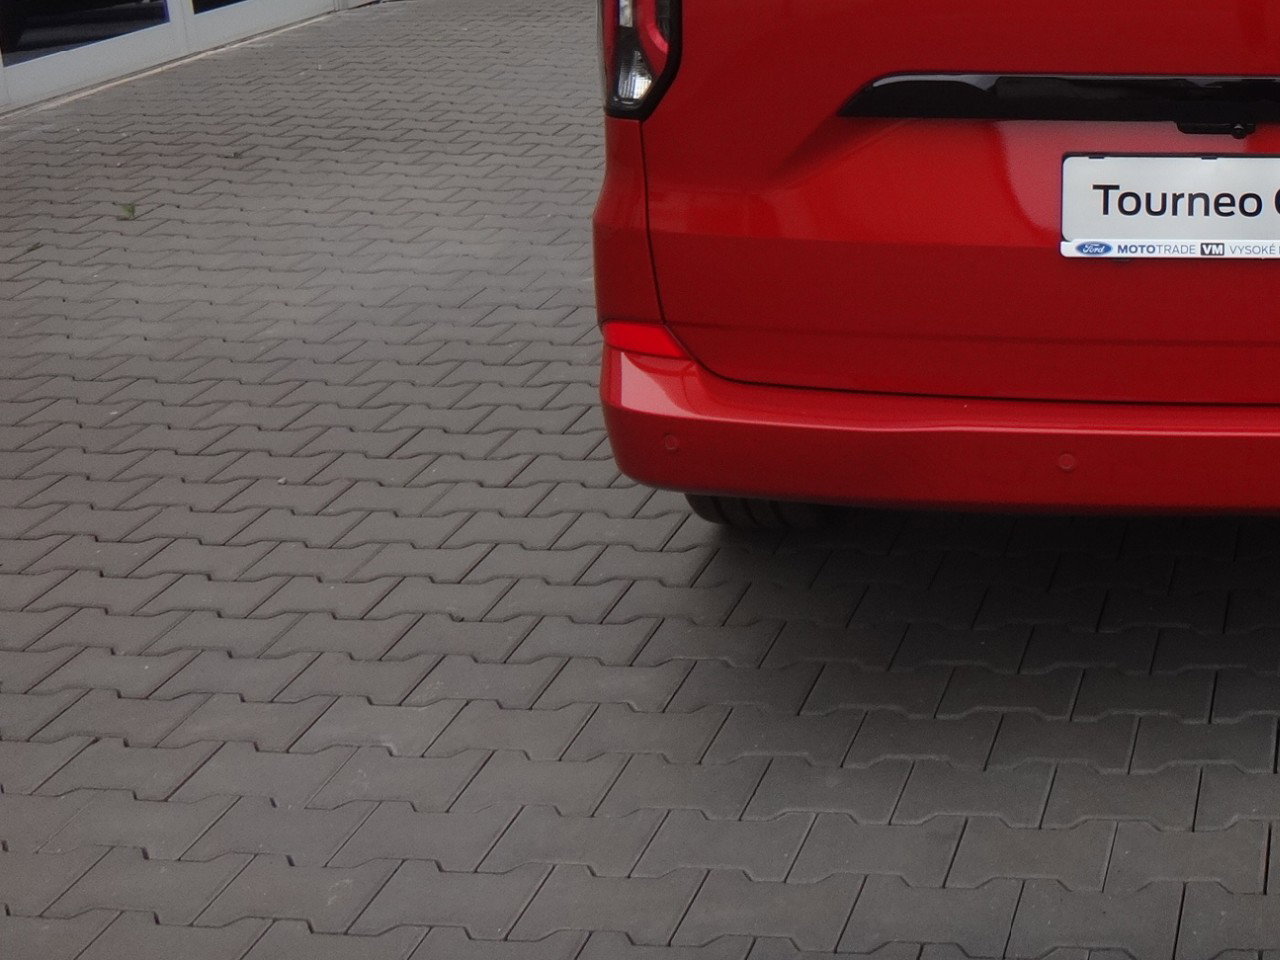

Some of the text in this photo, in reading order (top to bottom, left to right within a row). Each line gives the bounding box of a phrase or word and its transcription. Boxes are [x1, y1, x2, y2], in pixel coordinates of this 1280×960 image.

[1092, 184, 1263, 217] Tourneo
[1083, 244, 1106, 254] Ford
[1117, 244, 1196, 255] MOTOTRADE
[1202, 244, 1223, 255] VM
[1229, 243, 1276, 255] VYSOKÉ
